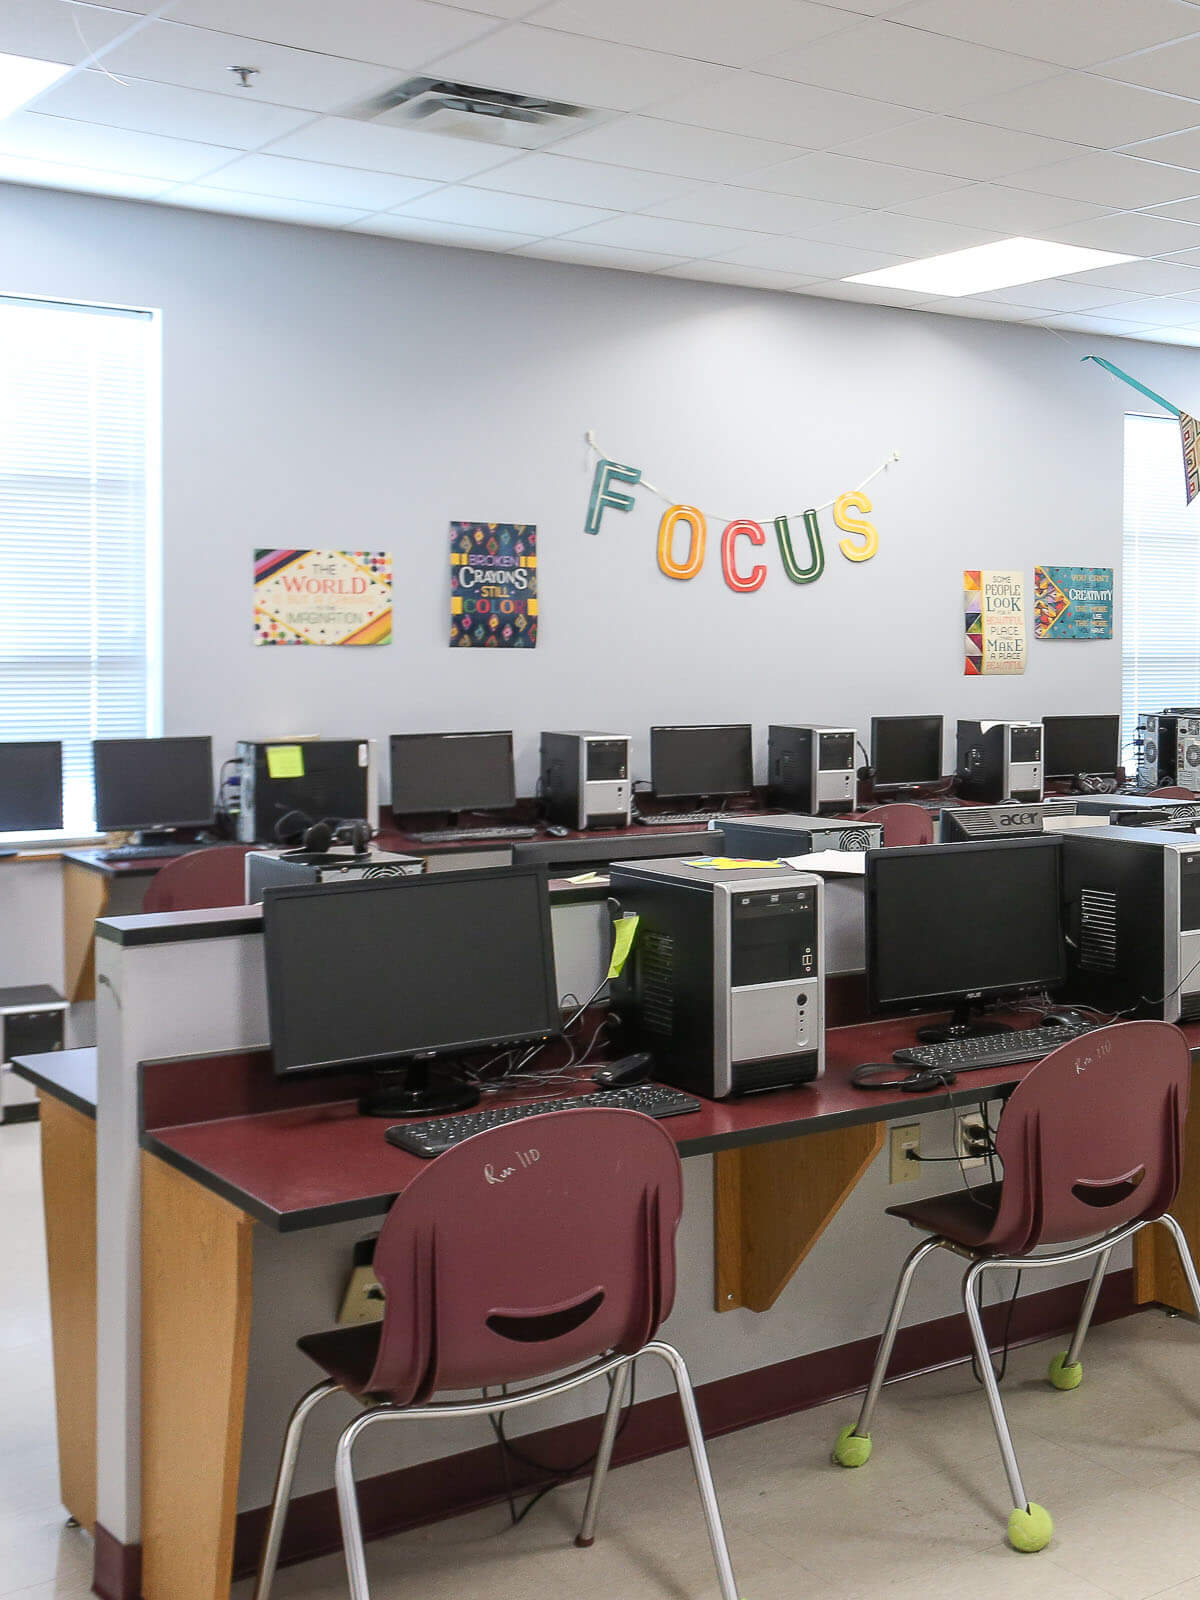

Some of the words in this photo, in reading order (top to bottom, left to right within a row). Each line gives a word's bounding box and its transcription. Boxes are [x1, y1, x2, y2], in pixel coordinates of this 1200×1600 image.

[584, 459, 879, 593] FOCUS
[468, 554, 520, 566] BROKEN
[312, 563, 336, 575] THE
[282, 575, 367, 594] WORLD
[459, 566, 528, 590] CRAYONS
[992, 575, 1012, 583] SOME
[480, 585, 511, 598] STILL
[985, 584, 1021, 596] PEOPLE
[1068, 588, 1112, 601] CREATIVITY
[463, 598, 526, 614] COLOR
[985, 596, 1021, 611] LOOK
[286, 611, 363, 624] IMAGINATION
[990, 626, 1019, 636] PLACE
[987, 638, 1024, 652] MAKE
[990, 652, 996, 660] A
[999, 652, 1021, 660] PLACE
[999, 812, 1039, 826] acer
[484, 1163, 517, 1185] Rm
